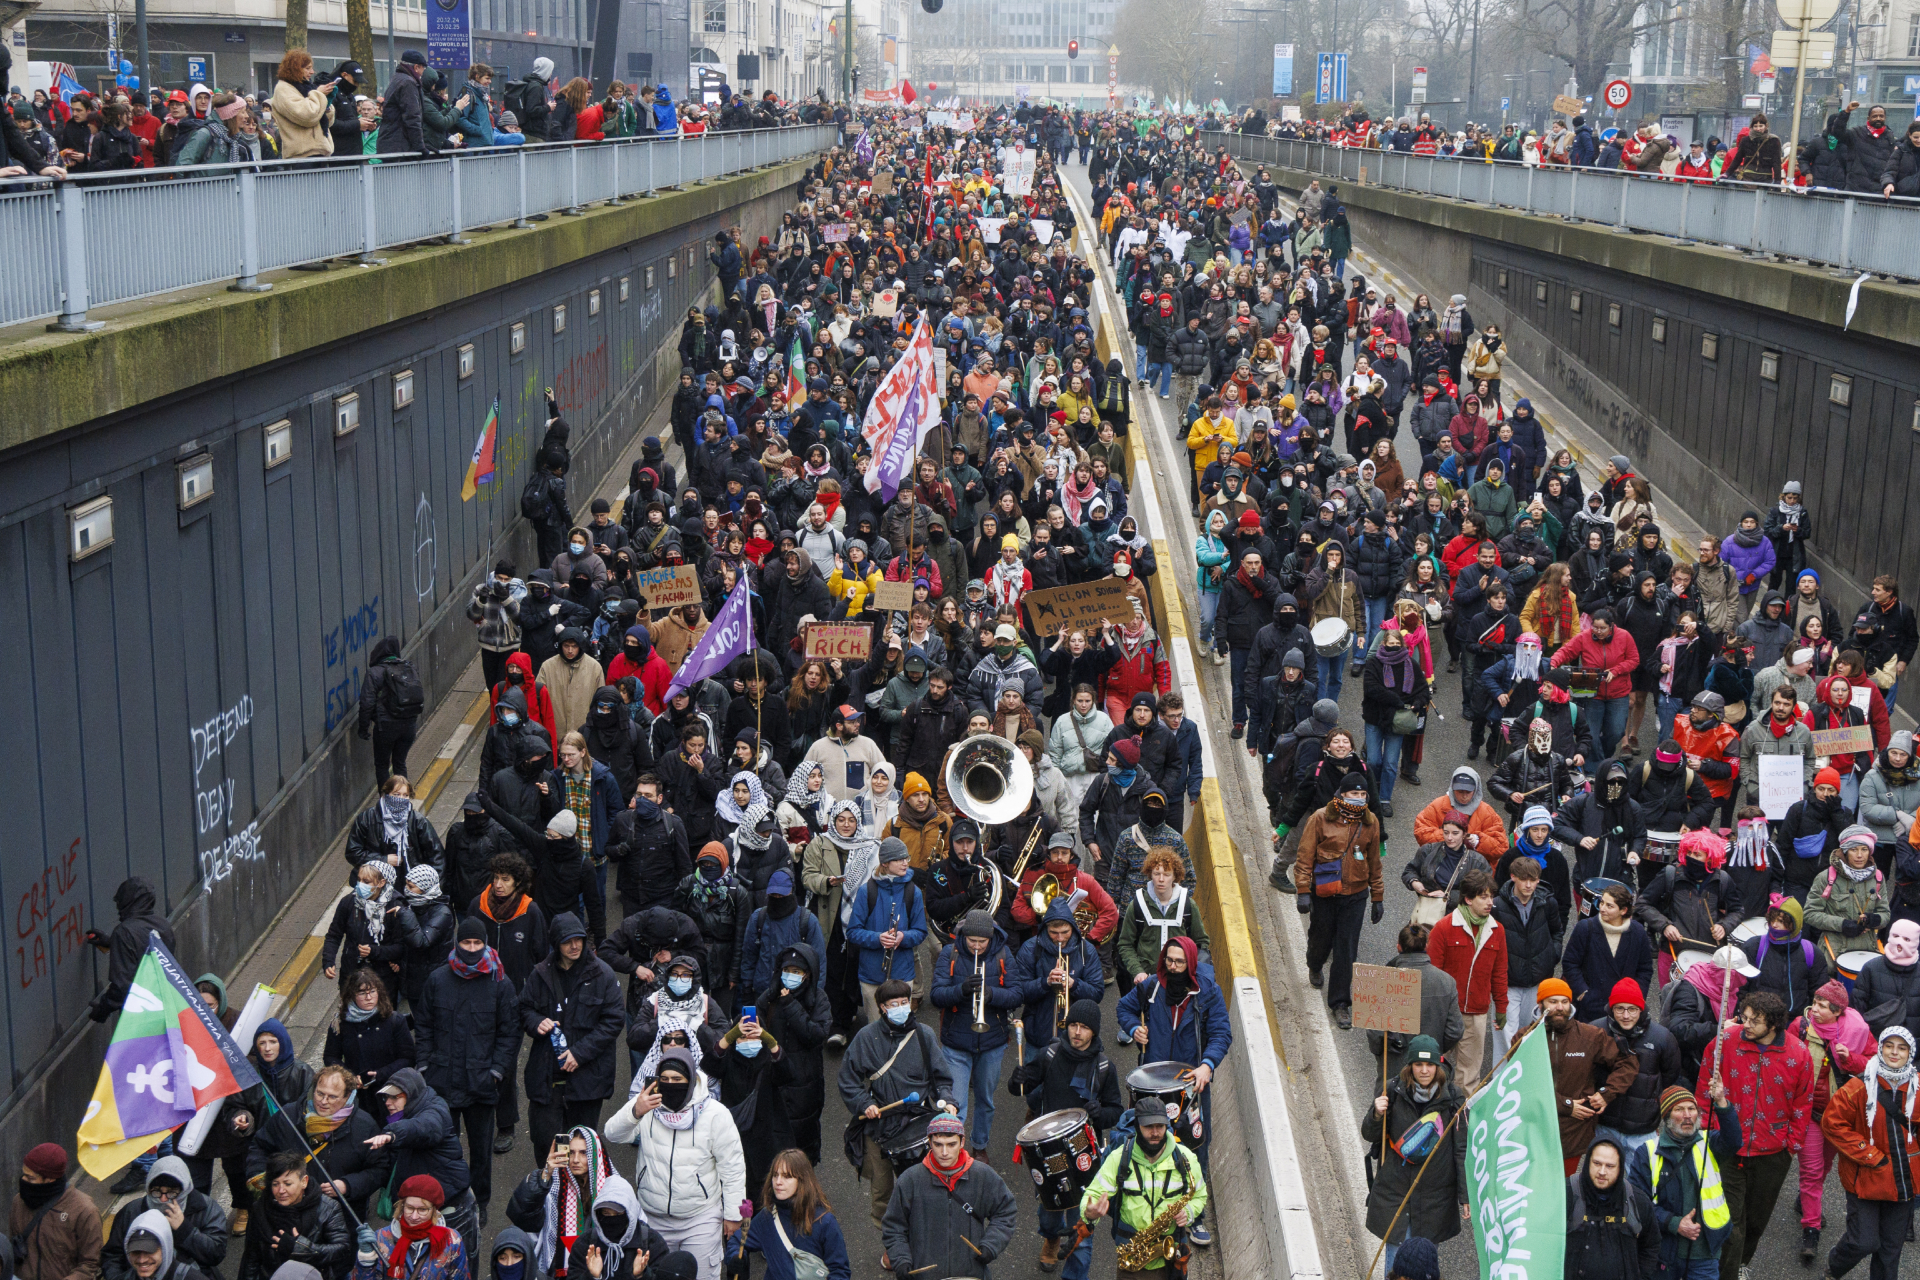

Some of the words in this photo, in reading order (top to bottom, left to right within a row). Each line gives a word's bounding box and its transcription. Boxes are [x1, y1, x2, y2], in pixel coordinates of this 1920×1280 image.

[1611, 87, 1626, 98] 50
[1857, 76, 1867, 91] M
[650, 580, 674, 594] MAIS
[676, 576, 694, 588] PAS
[1075, 588, 1092, 600] ON
[1060, 606, 1076, 619] LA
[340, 595, 378, 666] MONDE
[843, 627, 865, 638] THE
[326, 678, 350, 732] EST
[190, 694, 254, 789] DEFEND
[197, 778, 235, 834] DENY
[16, 934, 47, 989] LA
[1386, 983, 1412, 996] DIRE
[1353, 1011, 1410, 1032] FAIRE
